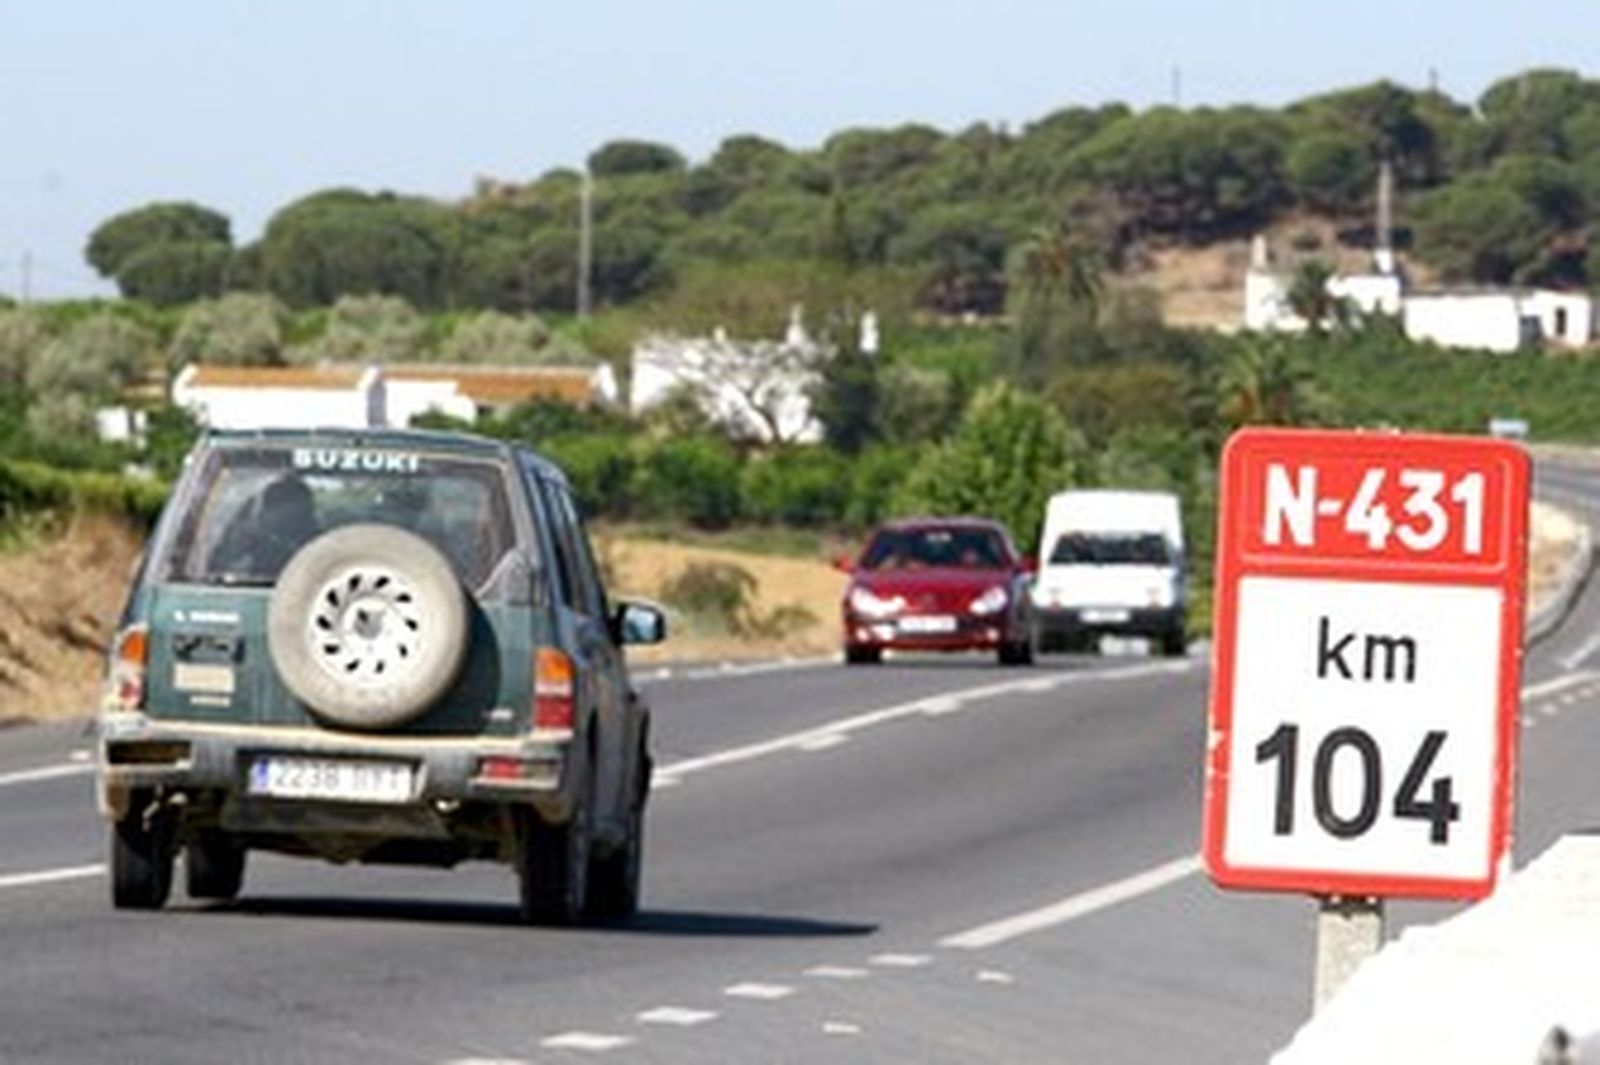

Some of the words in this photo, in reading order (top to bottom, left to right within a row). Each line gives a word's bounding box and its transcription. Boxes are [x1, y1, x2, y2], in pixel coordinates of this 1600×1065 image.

[293, 448, 419, 473] SUZUKI
[1263, 464, 1485, 555] N-431
[1317, 616, 1416, 682] km
[1255, 723, 1460, 844] 104
